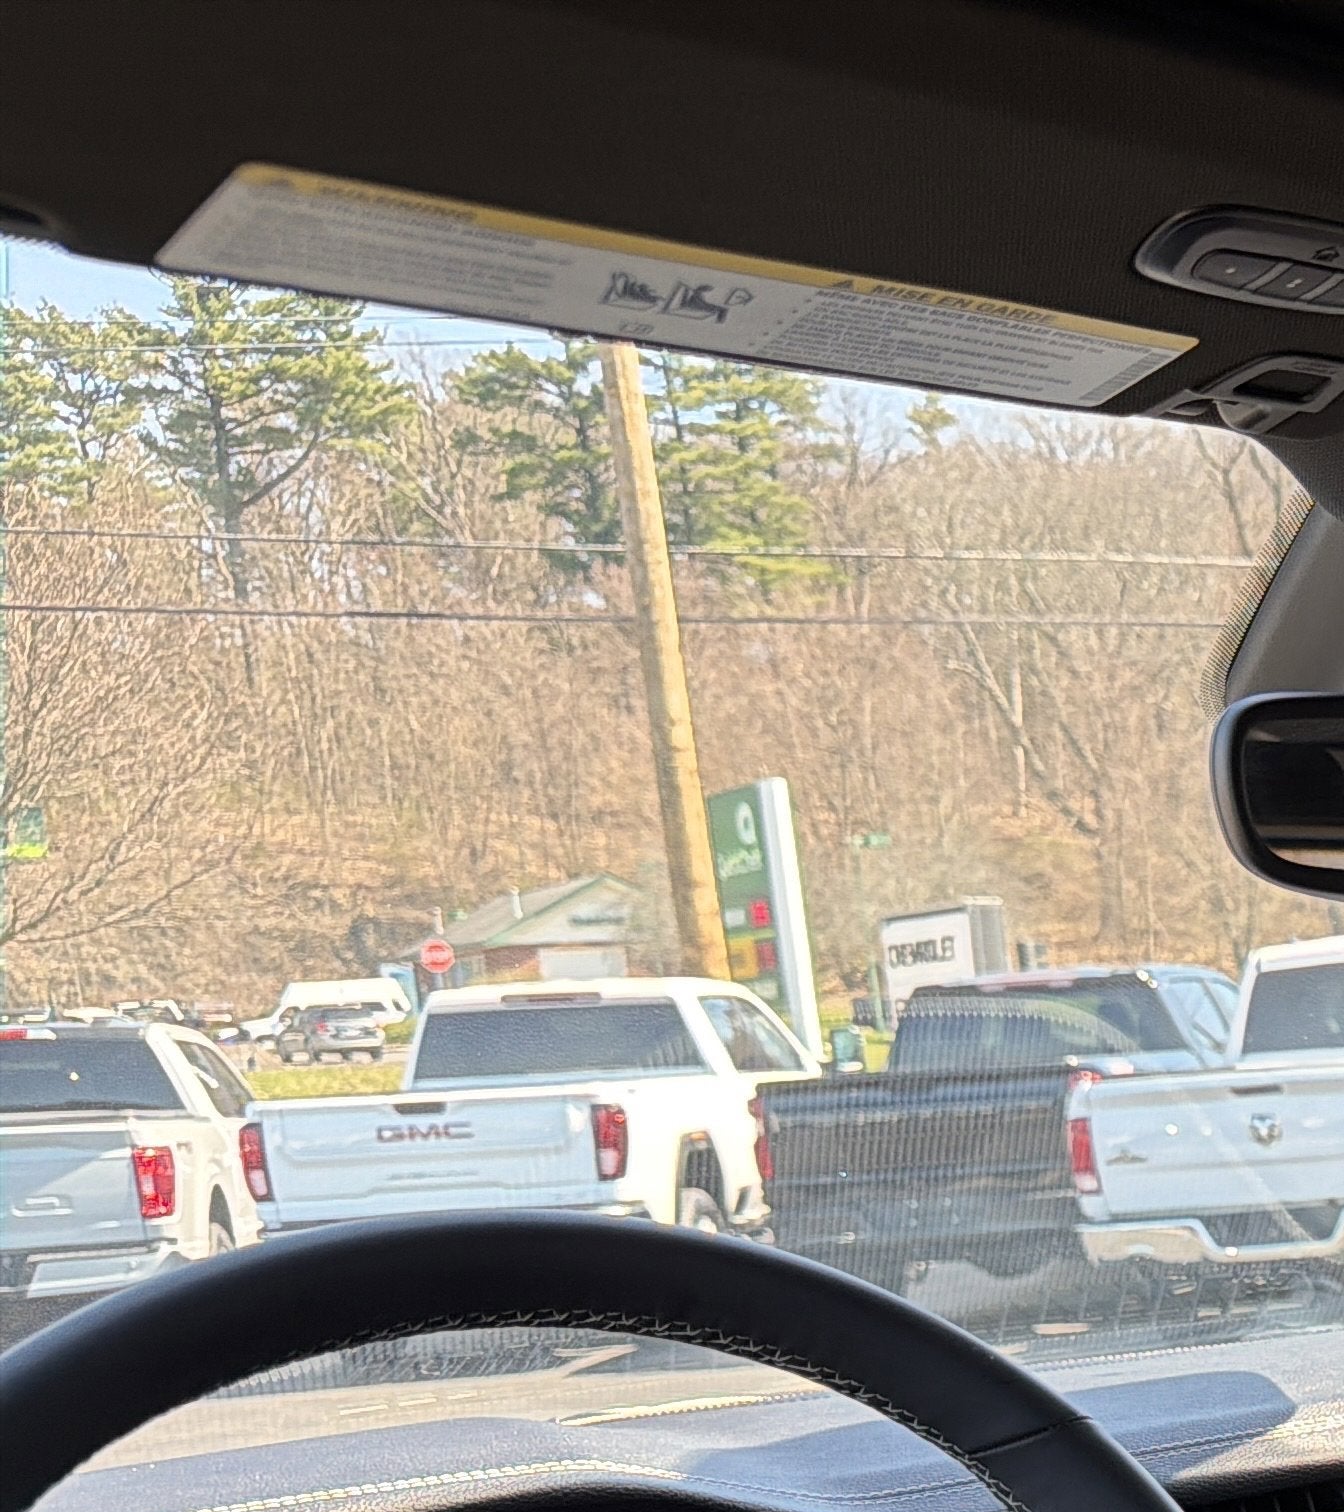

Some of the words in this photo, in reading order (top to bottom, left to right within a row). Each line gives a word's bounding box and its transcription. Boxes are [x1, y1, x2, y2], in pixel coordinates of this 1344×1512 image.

[872, 284, 936, 303] MISE
[938, 295, 975, 310] EN
[976, 302, 1056, 324] GARDE
[376, 1121, 476, 1143] GMC
